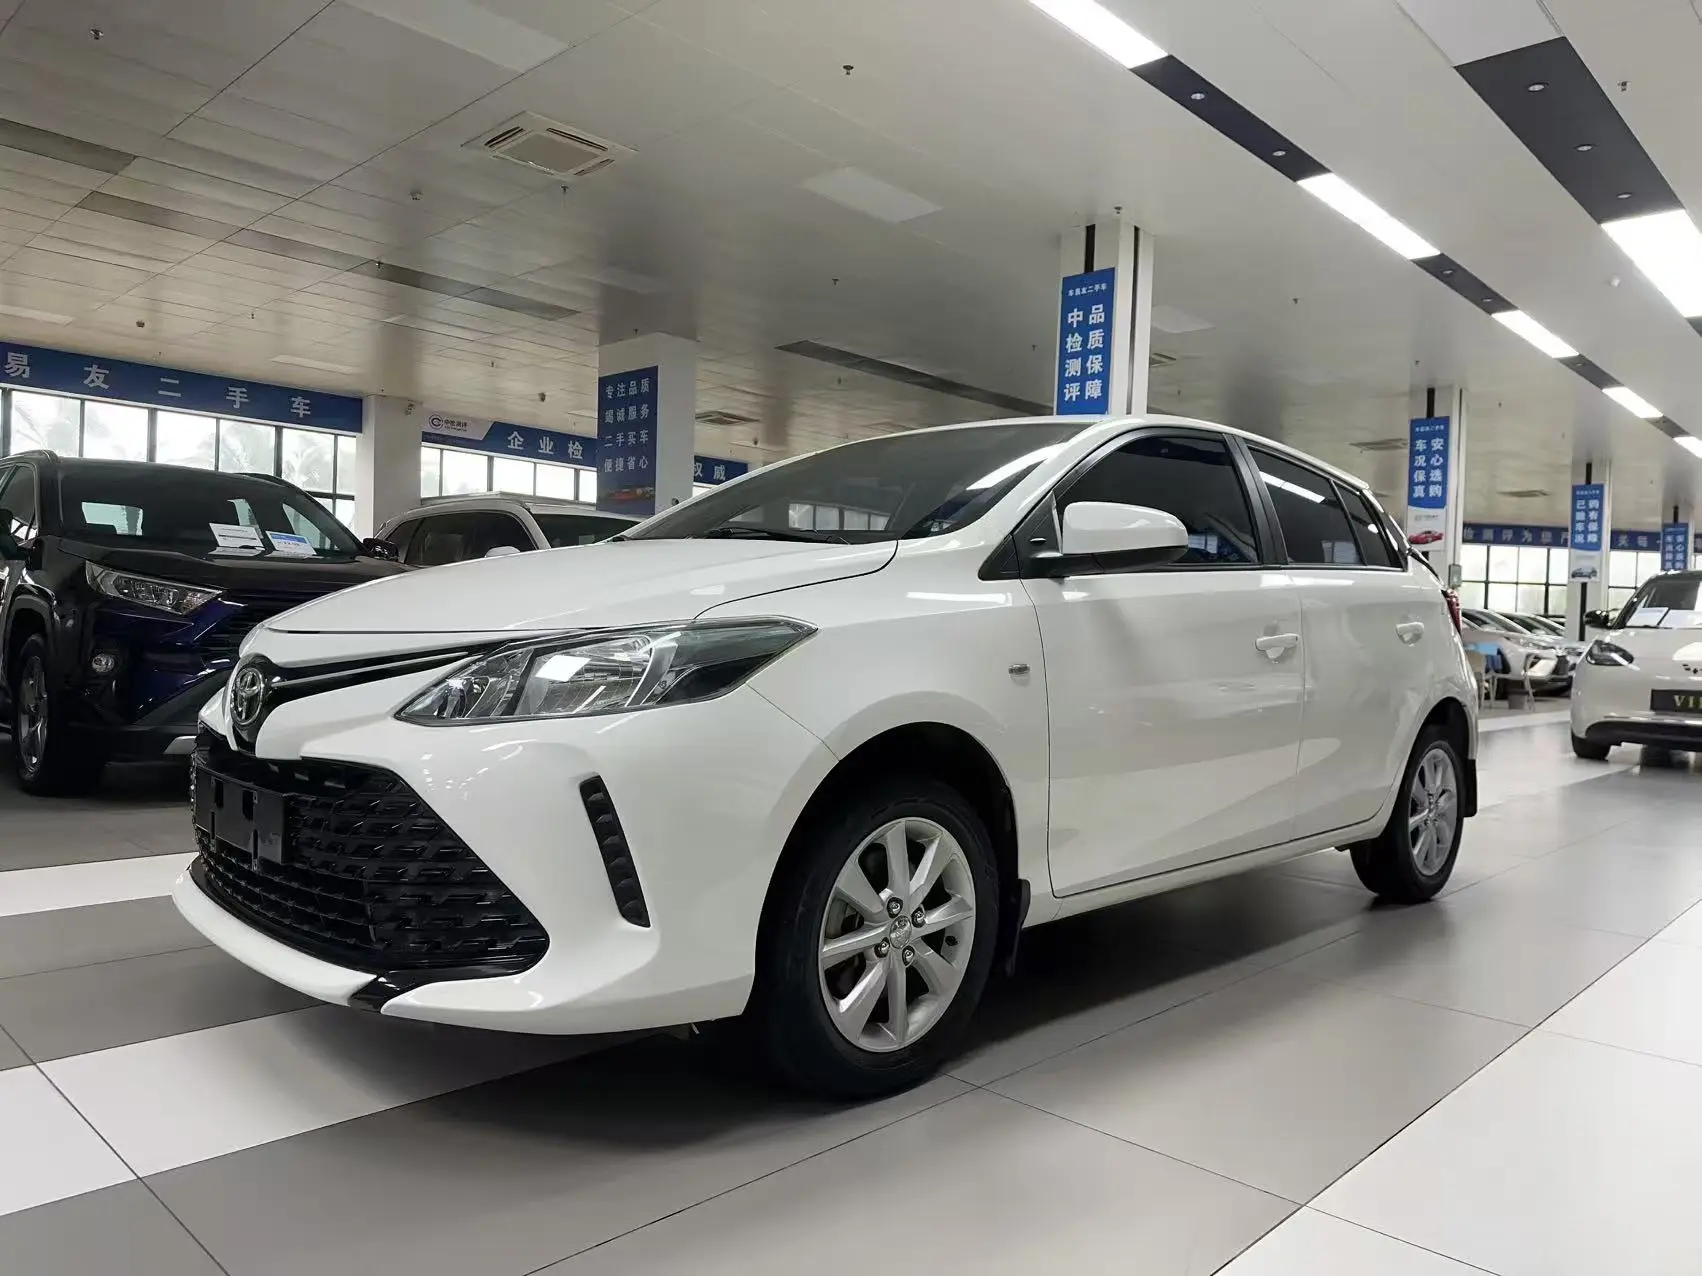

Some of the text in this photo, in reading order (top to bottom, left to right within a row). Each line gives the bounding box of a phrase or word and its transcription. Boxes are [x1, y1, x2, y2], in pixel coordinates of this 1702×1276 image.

[1063, 308, 1084, 402] 中检测评
[1085, 304, 1105, 400] 品质保障
[4, 352, 312, 419] 易友二手车
[605, 378, 650, 399] 专注品质
[604, 404, 650, 424] 竭诚服务
[604, 429, 649, 448] 二手买车
[603, 455, 649, 473] 便捷省心
[1413, 440, 1427, 498] 车况保真
[1428, 438, 1444, 498] 安心选购
[1674, 695, 1702, 708] VI
